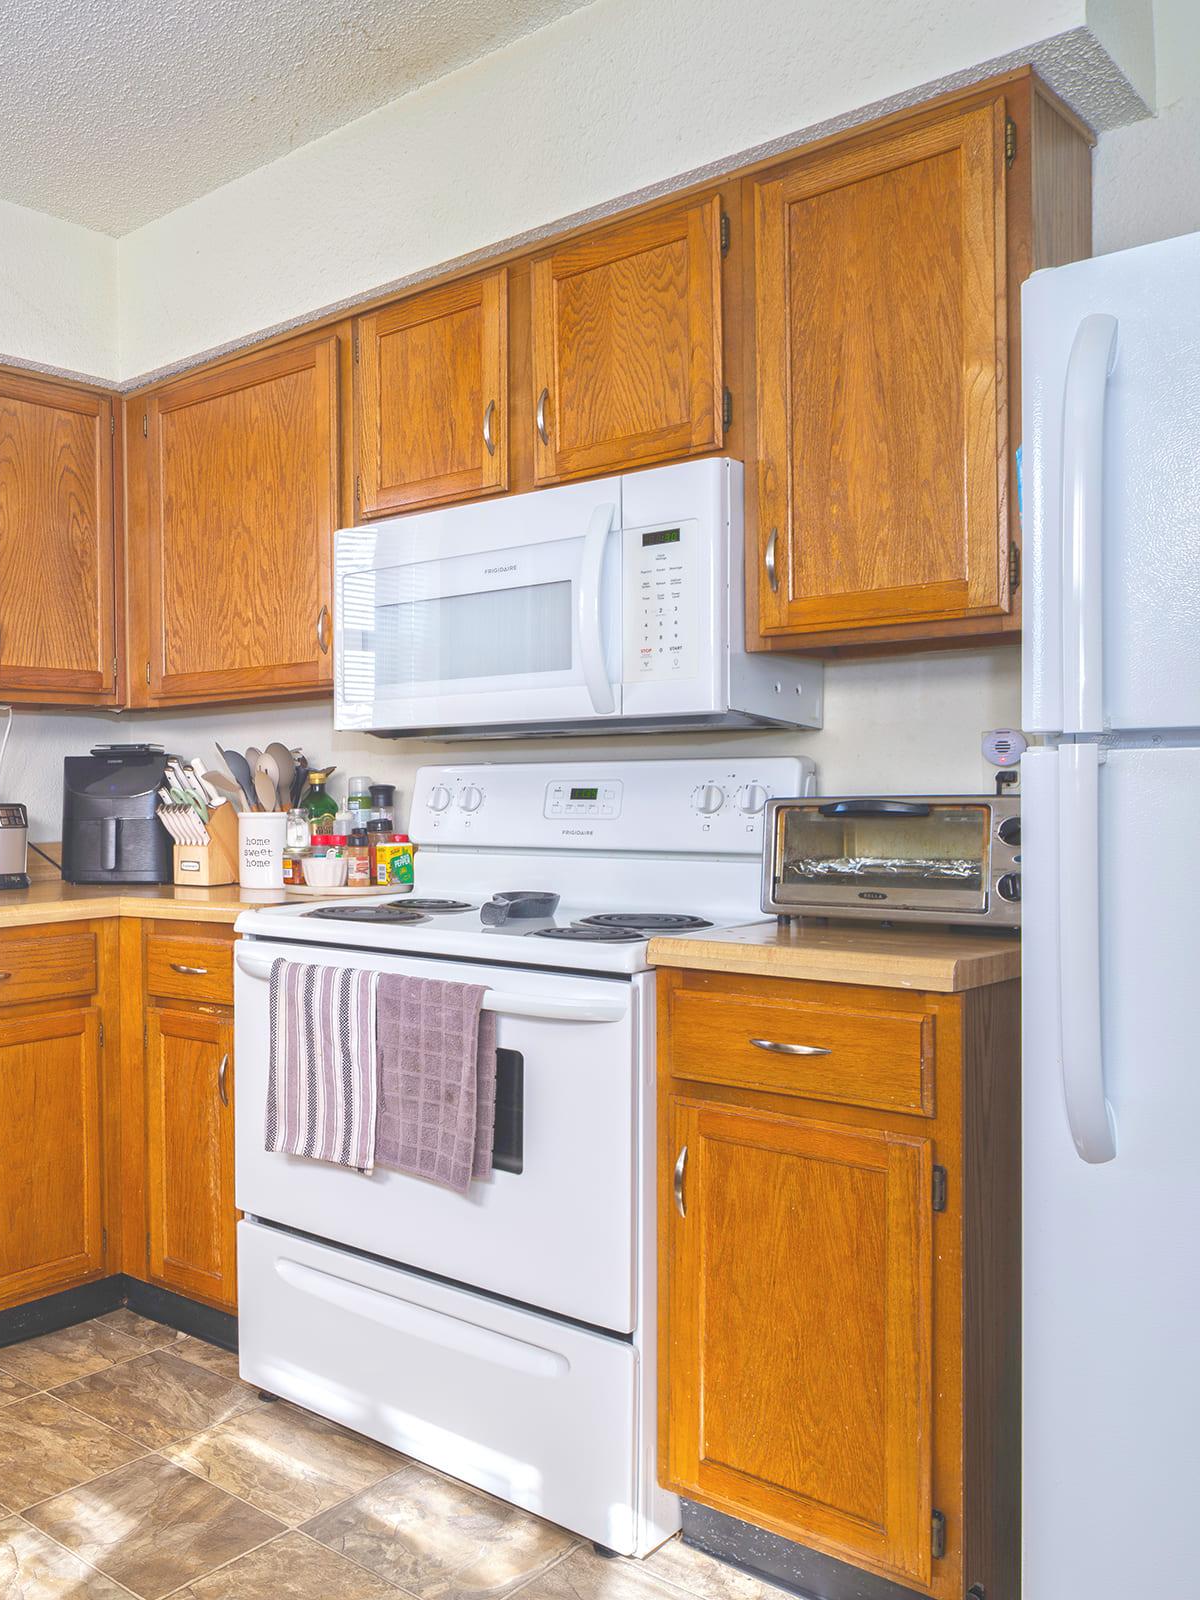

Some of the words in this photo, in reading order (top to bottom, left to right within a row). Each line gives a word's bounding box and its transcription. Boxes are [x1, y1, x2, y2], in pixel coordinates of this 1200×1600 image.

[484, 564, 518, 575] FRIGIDAIRE
[561, 829, 594, 837] FRIGIDAIRE
[245, 837, 271, 846] home
[243, 848, 274, 858] sweet
[245, 858, 271, 868] home
